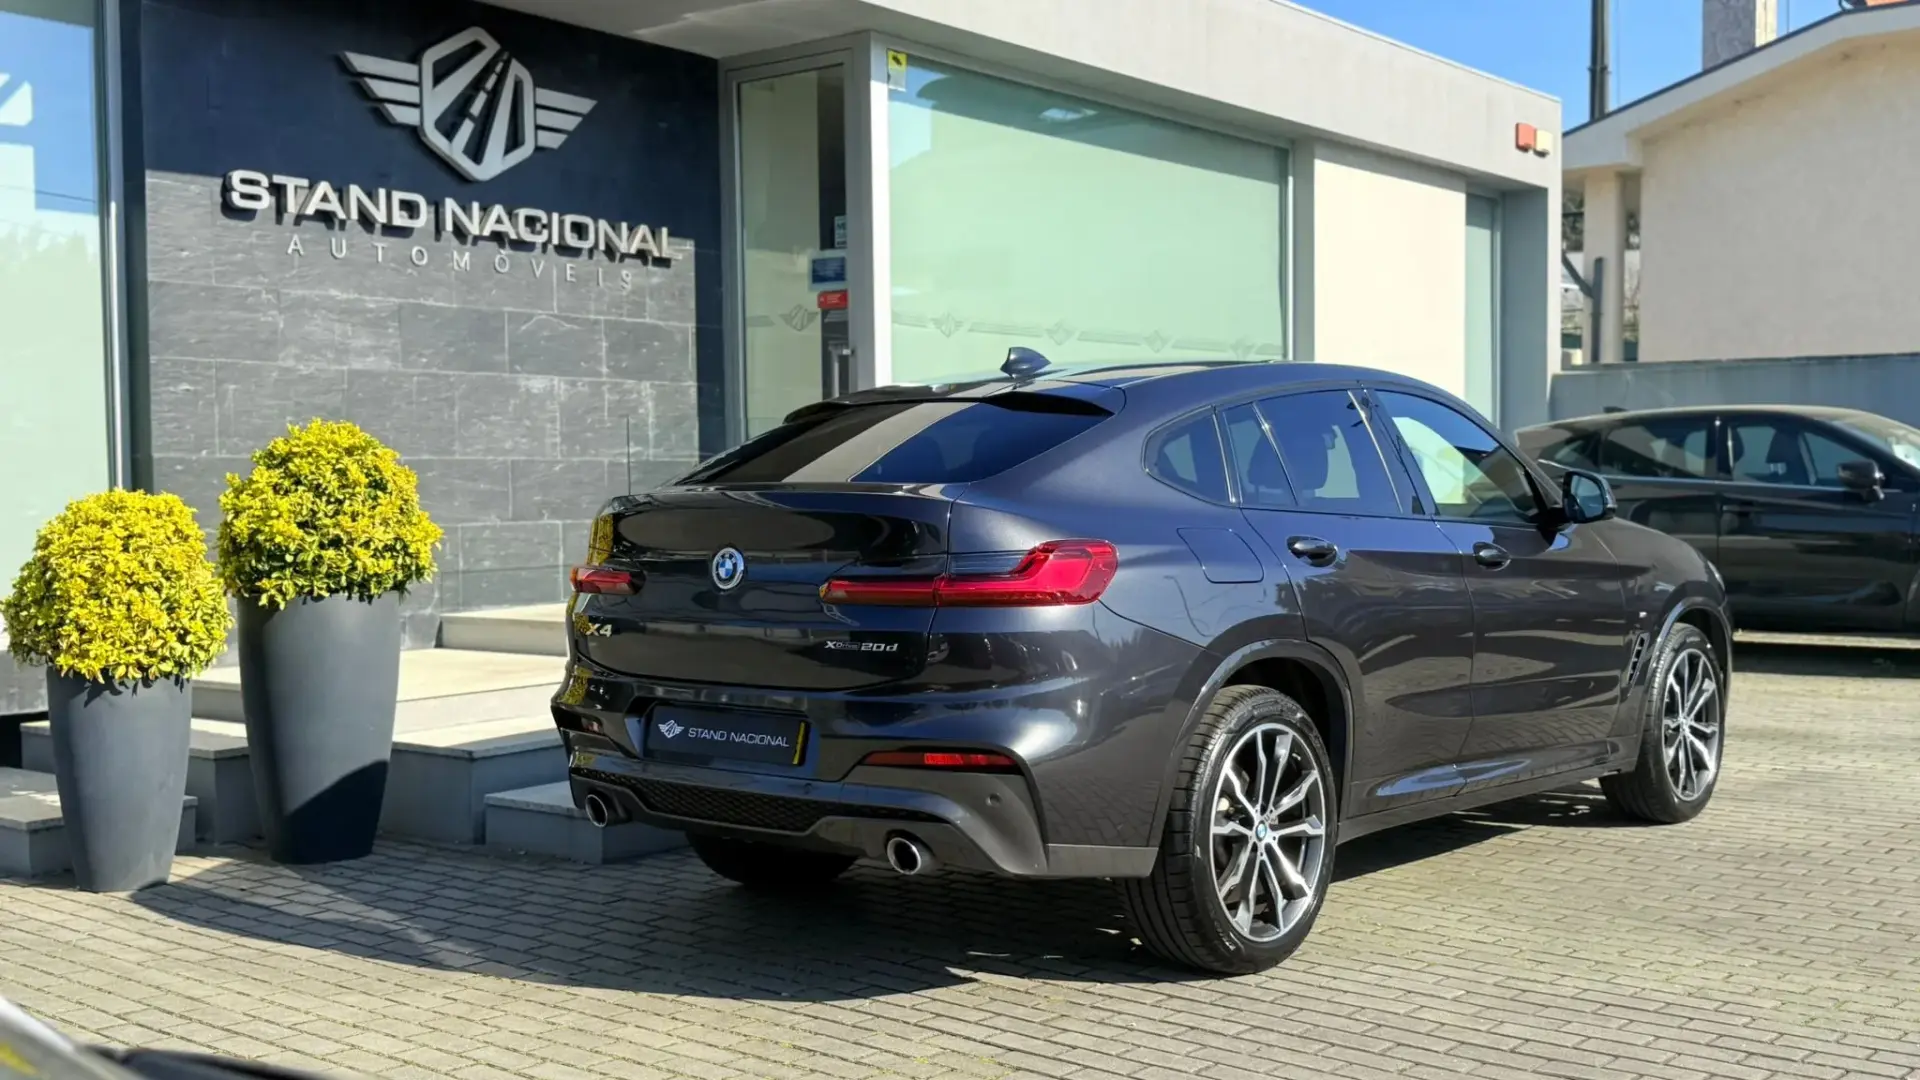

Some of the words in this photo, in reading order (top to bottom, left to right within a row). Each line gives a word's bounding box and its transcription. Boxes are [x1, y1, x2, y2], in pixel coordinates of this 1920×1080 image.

[229, 169, 428, 229] STAND
[445, 197, 683, 260] NACIONAL
[585, 622, 613, 638] X4
[688, 727, 727, 741] STAND
[730, 732, 790, 747] NACIONAL
